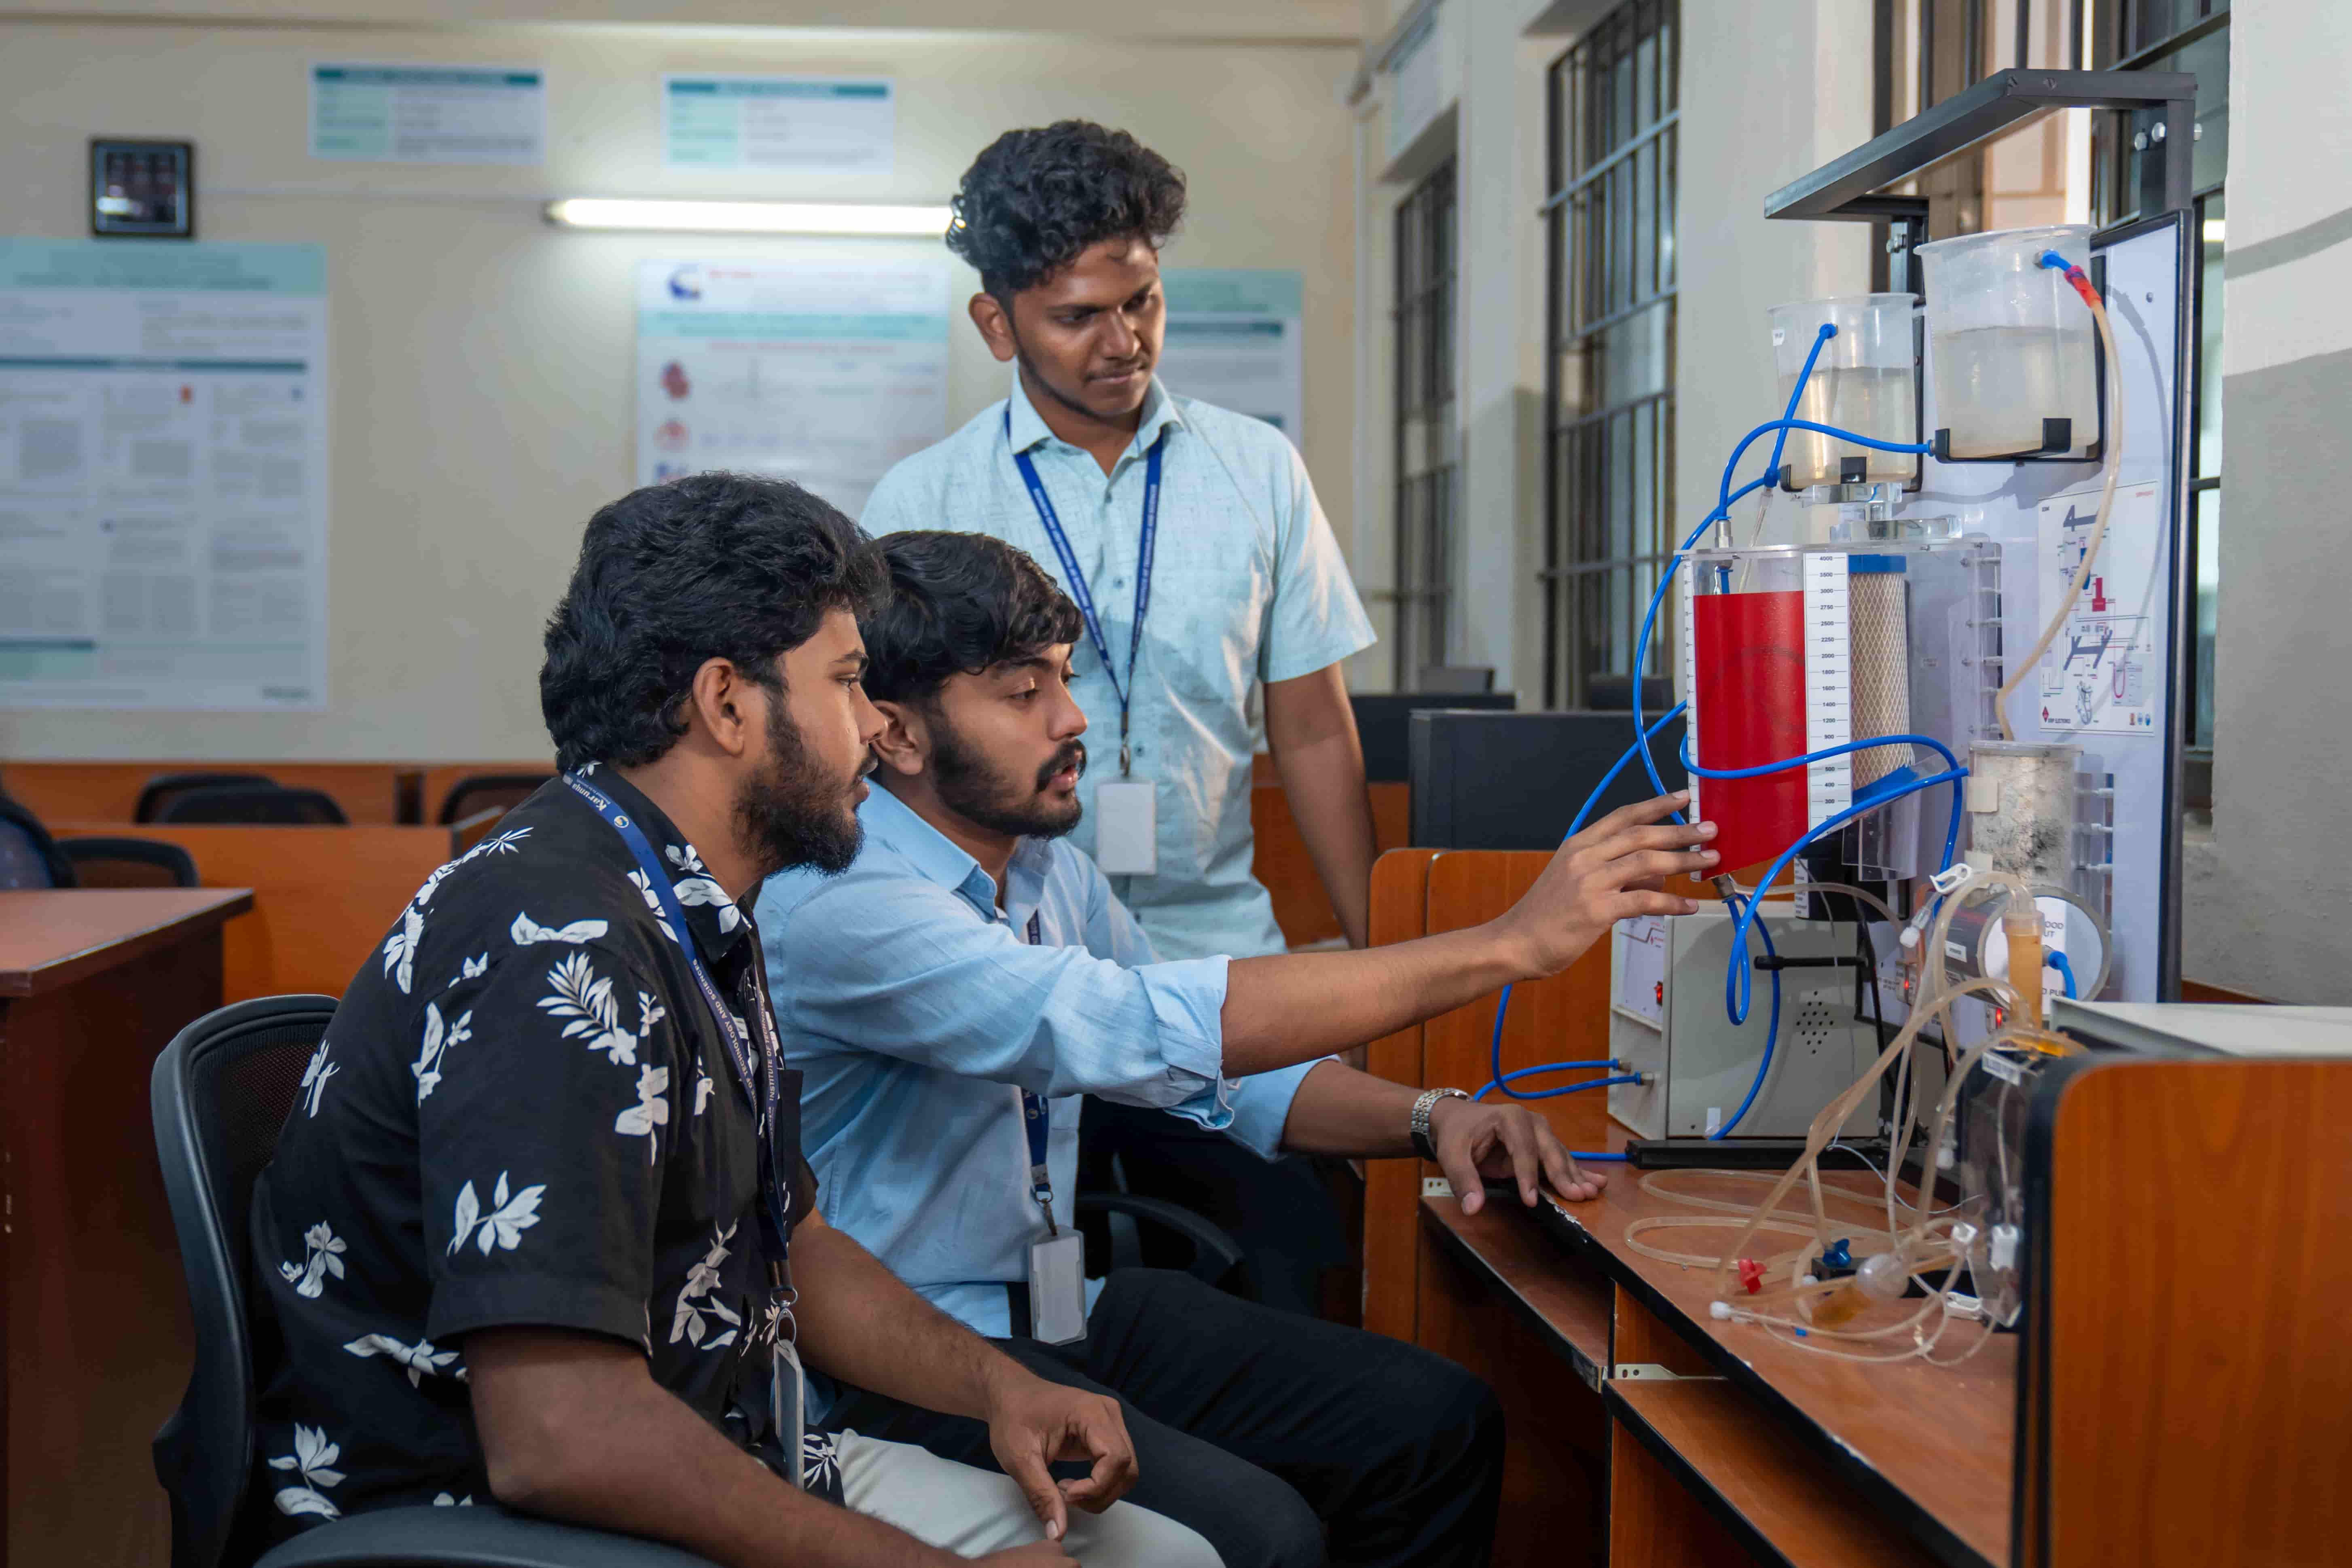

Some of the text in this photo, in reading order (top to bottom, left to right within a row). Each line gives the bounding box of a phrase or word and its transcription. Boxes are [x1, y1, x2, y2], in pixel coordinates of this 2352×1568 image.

[572, 783, 607, 811] Karunya
[2045, 921, 2064, 929] OOD
[693, 958, 717, 1000] SCIENCES
[715, 1001, 728, 1019] AND
[724, 1021, 748, 1077] TECHNOLOGY
[767, 1059, 775, 1101] INSTITUTE
